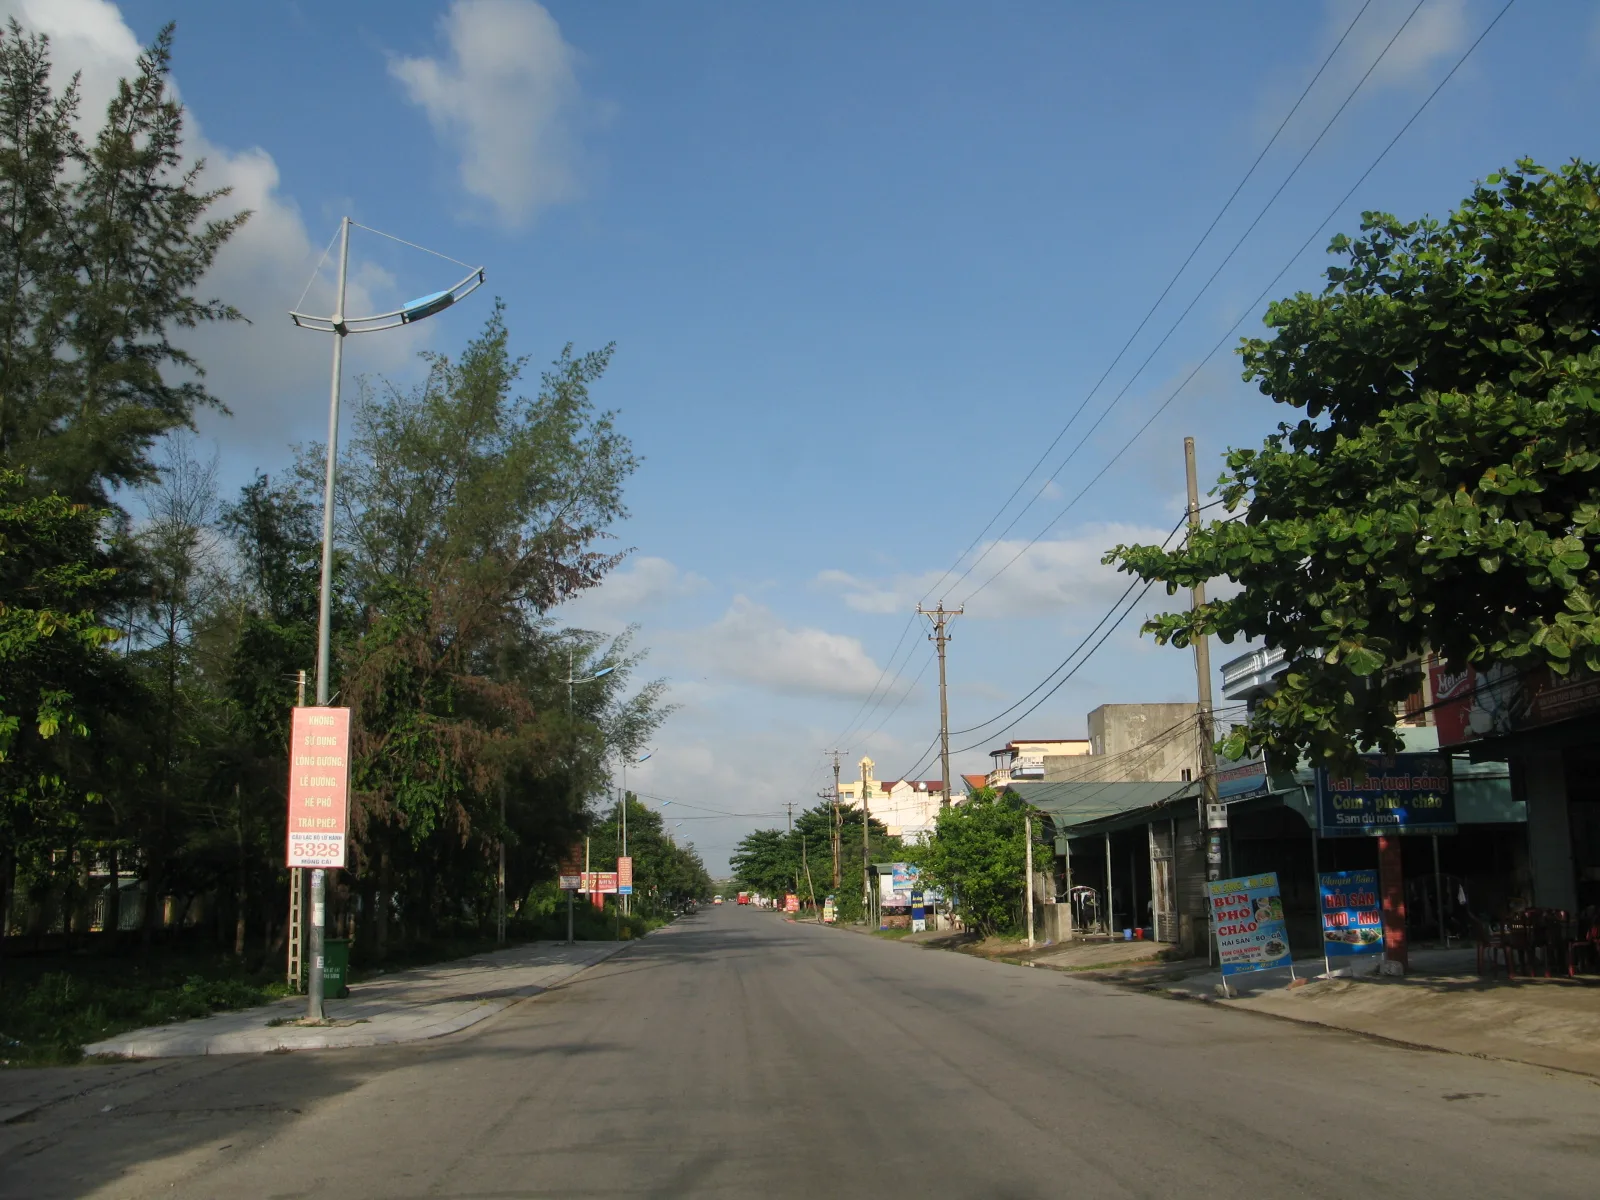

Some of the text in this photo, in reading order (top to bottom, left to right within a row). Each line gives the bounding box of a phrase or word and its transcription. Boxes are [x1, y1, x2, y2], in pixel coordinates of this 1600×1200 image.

[293, 842, 340, 857] 5328
[581, 879, 597, 888] 37
[1213, 893, 1249, 907] BÚN
[1325, 886, 1375, 909] HẢI SẢN
[1218, 920, 1258, 937] CHÁO
